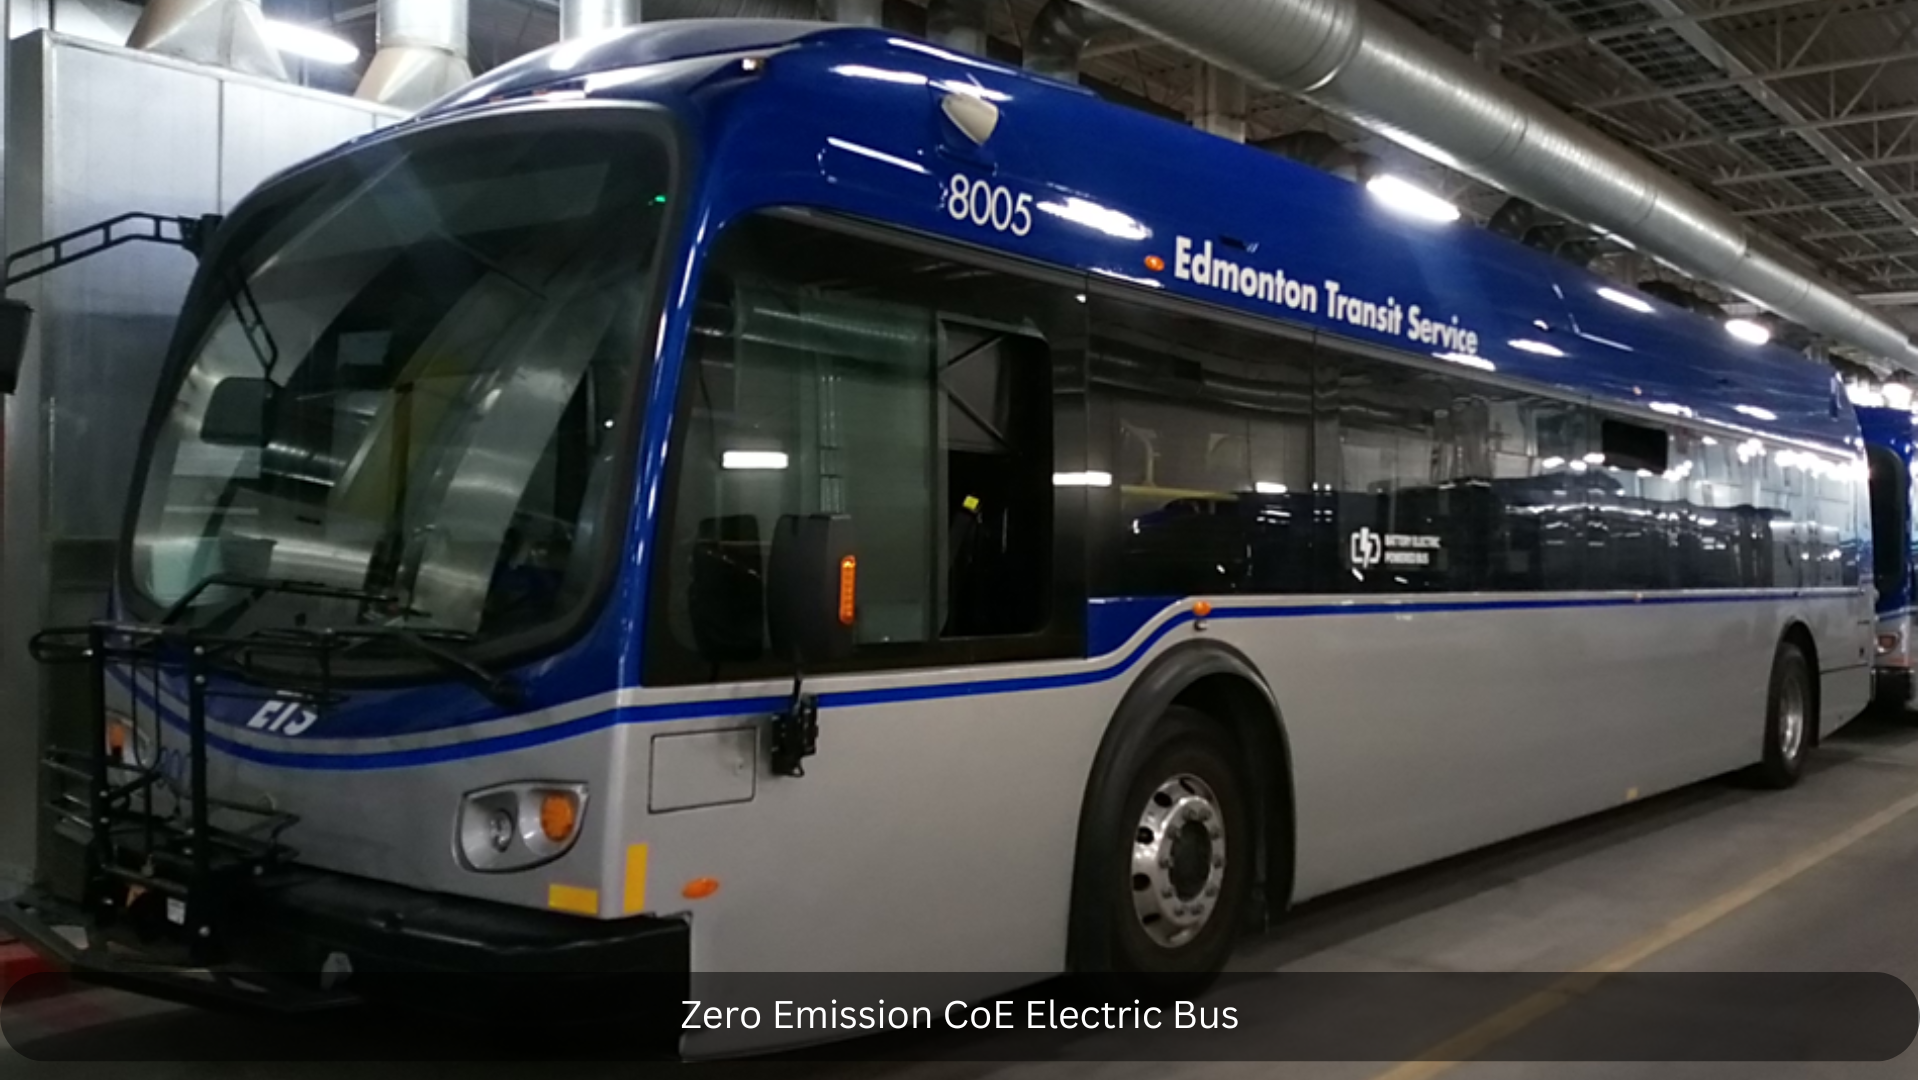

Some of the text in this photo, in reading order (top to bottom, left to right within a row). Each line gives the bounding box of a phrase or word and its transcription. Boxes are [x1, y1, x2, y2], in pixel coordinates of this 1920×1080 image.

[948, 173, 1033, 237] 8005
[1174, 236, 1478, 355] Edmonton Transit Service
